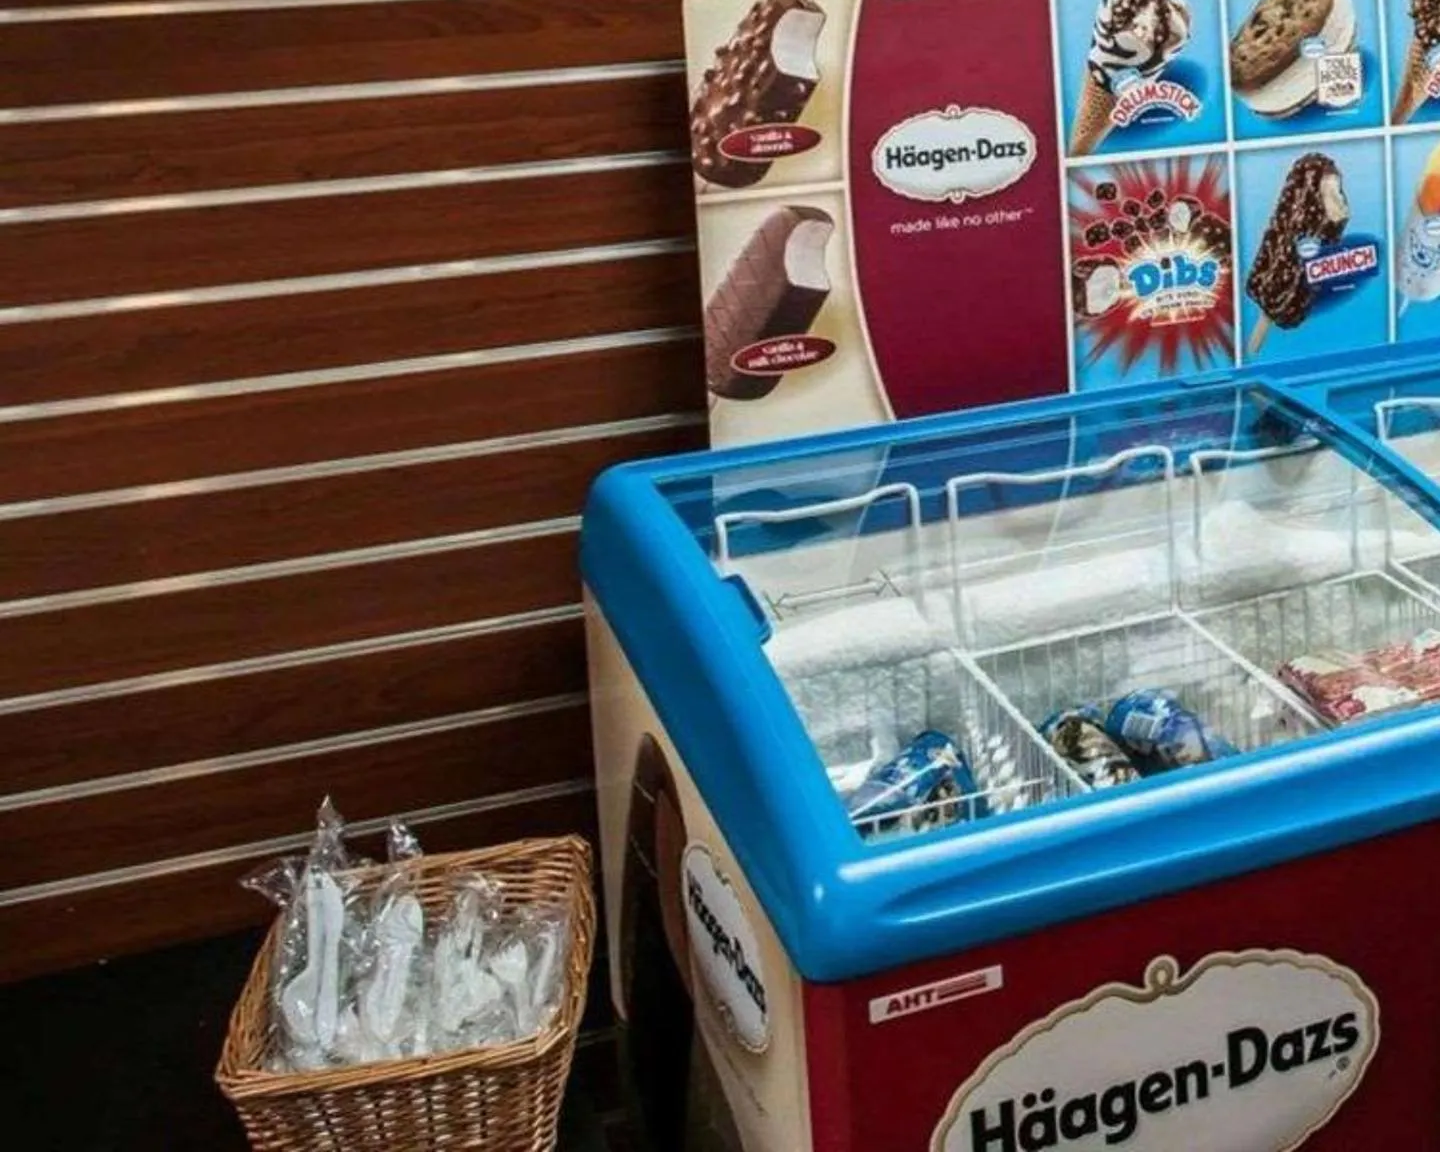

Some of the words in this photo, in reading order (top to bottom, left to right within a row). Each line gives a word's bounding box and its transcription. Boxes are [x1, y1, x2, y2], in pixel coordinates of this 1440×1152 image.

[1112, 82, 1200, 124] DRUMSTICK
[885, 137, 1028, 171] Häagen-Dazs
[890, 217, 932, 235] made
[935, 216, 961, 230] like
[963, 214, 982, 228] no
[1128, 254, 1218, 297] Dibs
[1309, 248, 1374, 279] CRUNCH
[886, 987, 938, 1015] AHT
[969, 1011, 1360, 1152] Häagen-Dazs
